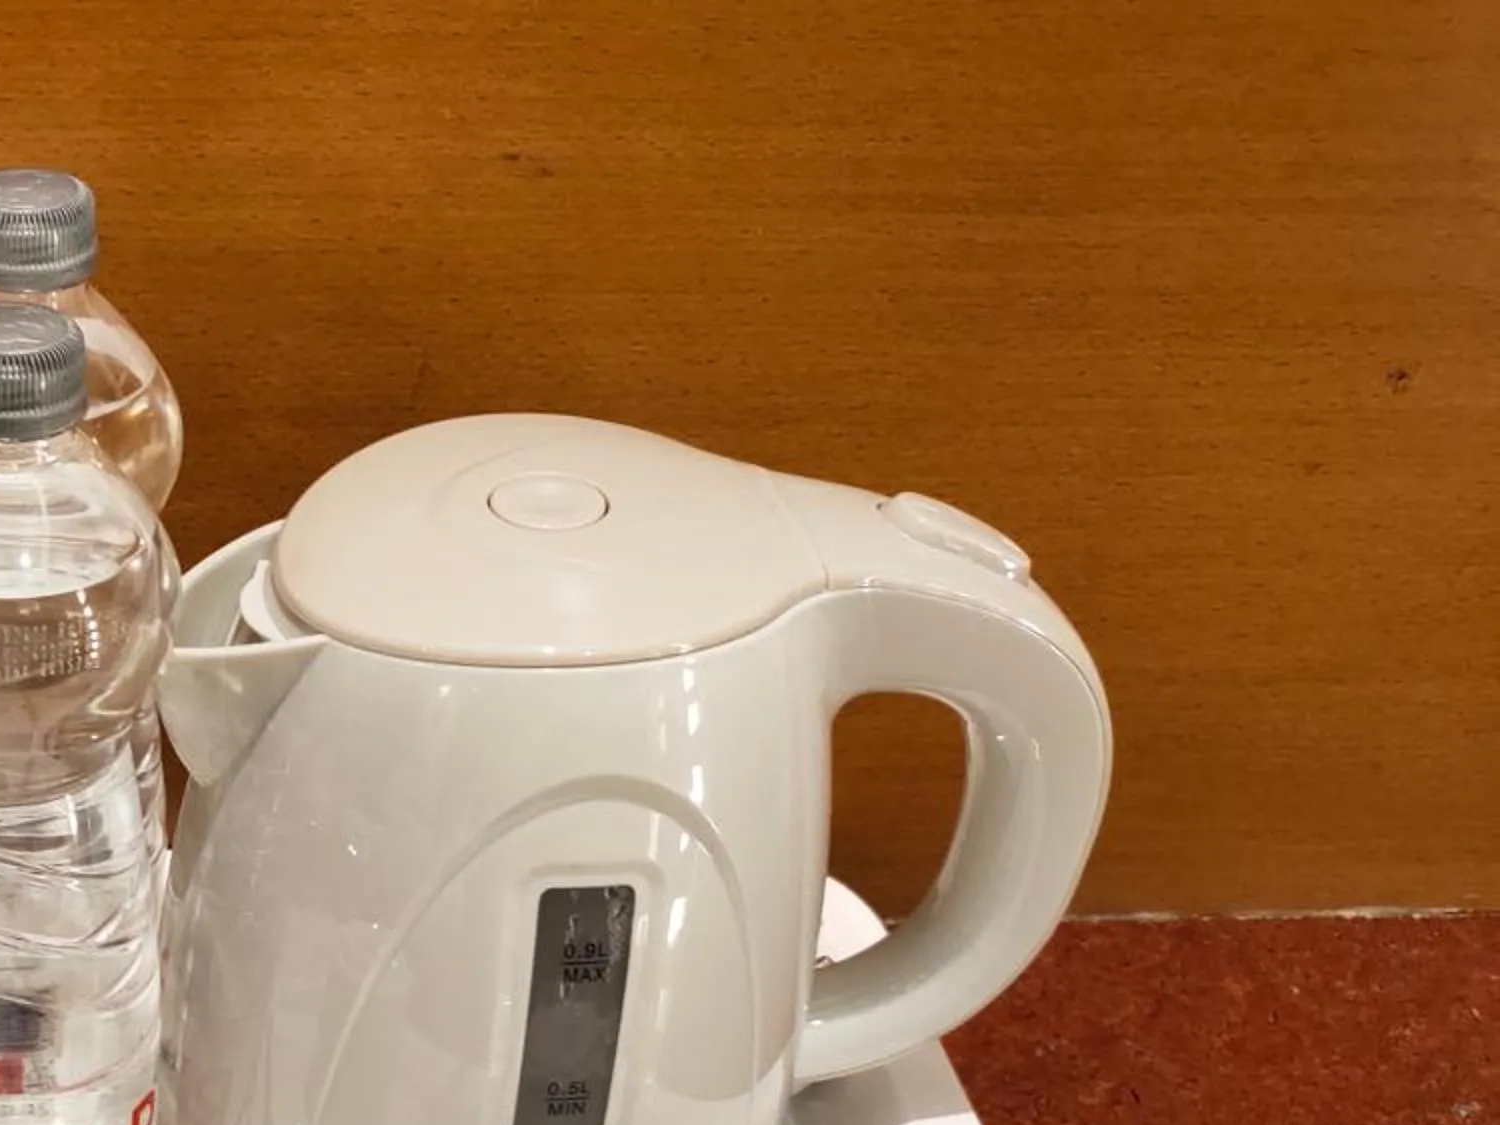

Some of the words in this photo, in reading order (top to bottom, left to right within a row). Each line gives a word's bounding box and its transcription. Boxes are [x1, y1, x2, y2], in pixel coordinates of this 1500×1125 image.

[563, 968, 607, 984] MAX
[547, 1081, 591, 1096] 0.5L
[547, 1102, 586, 1117] MIN
